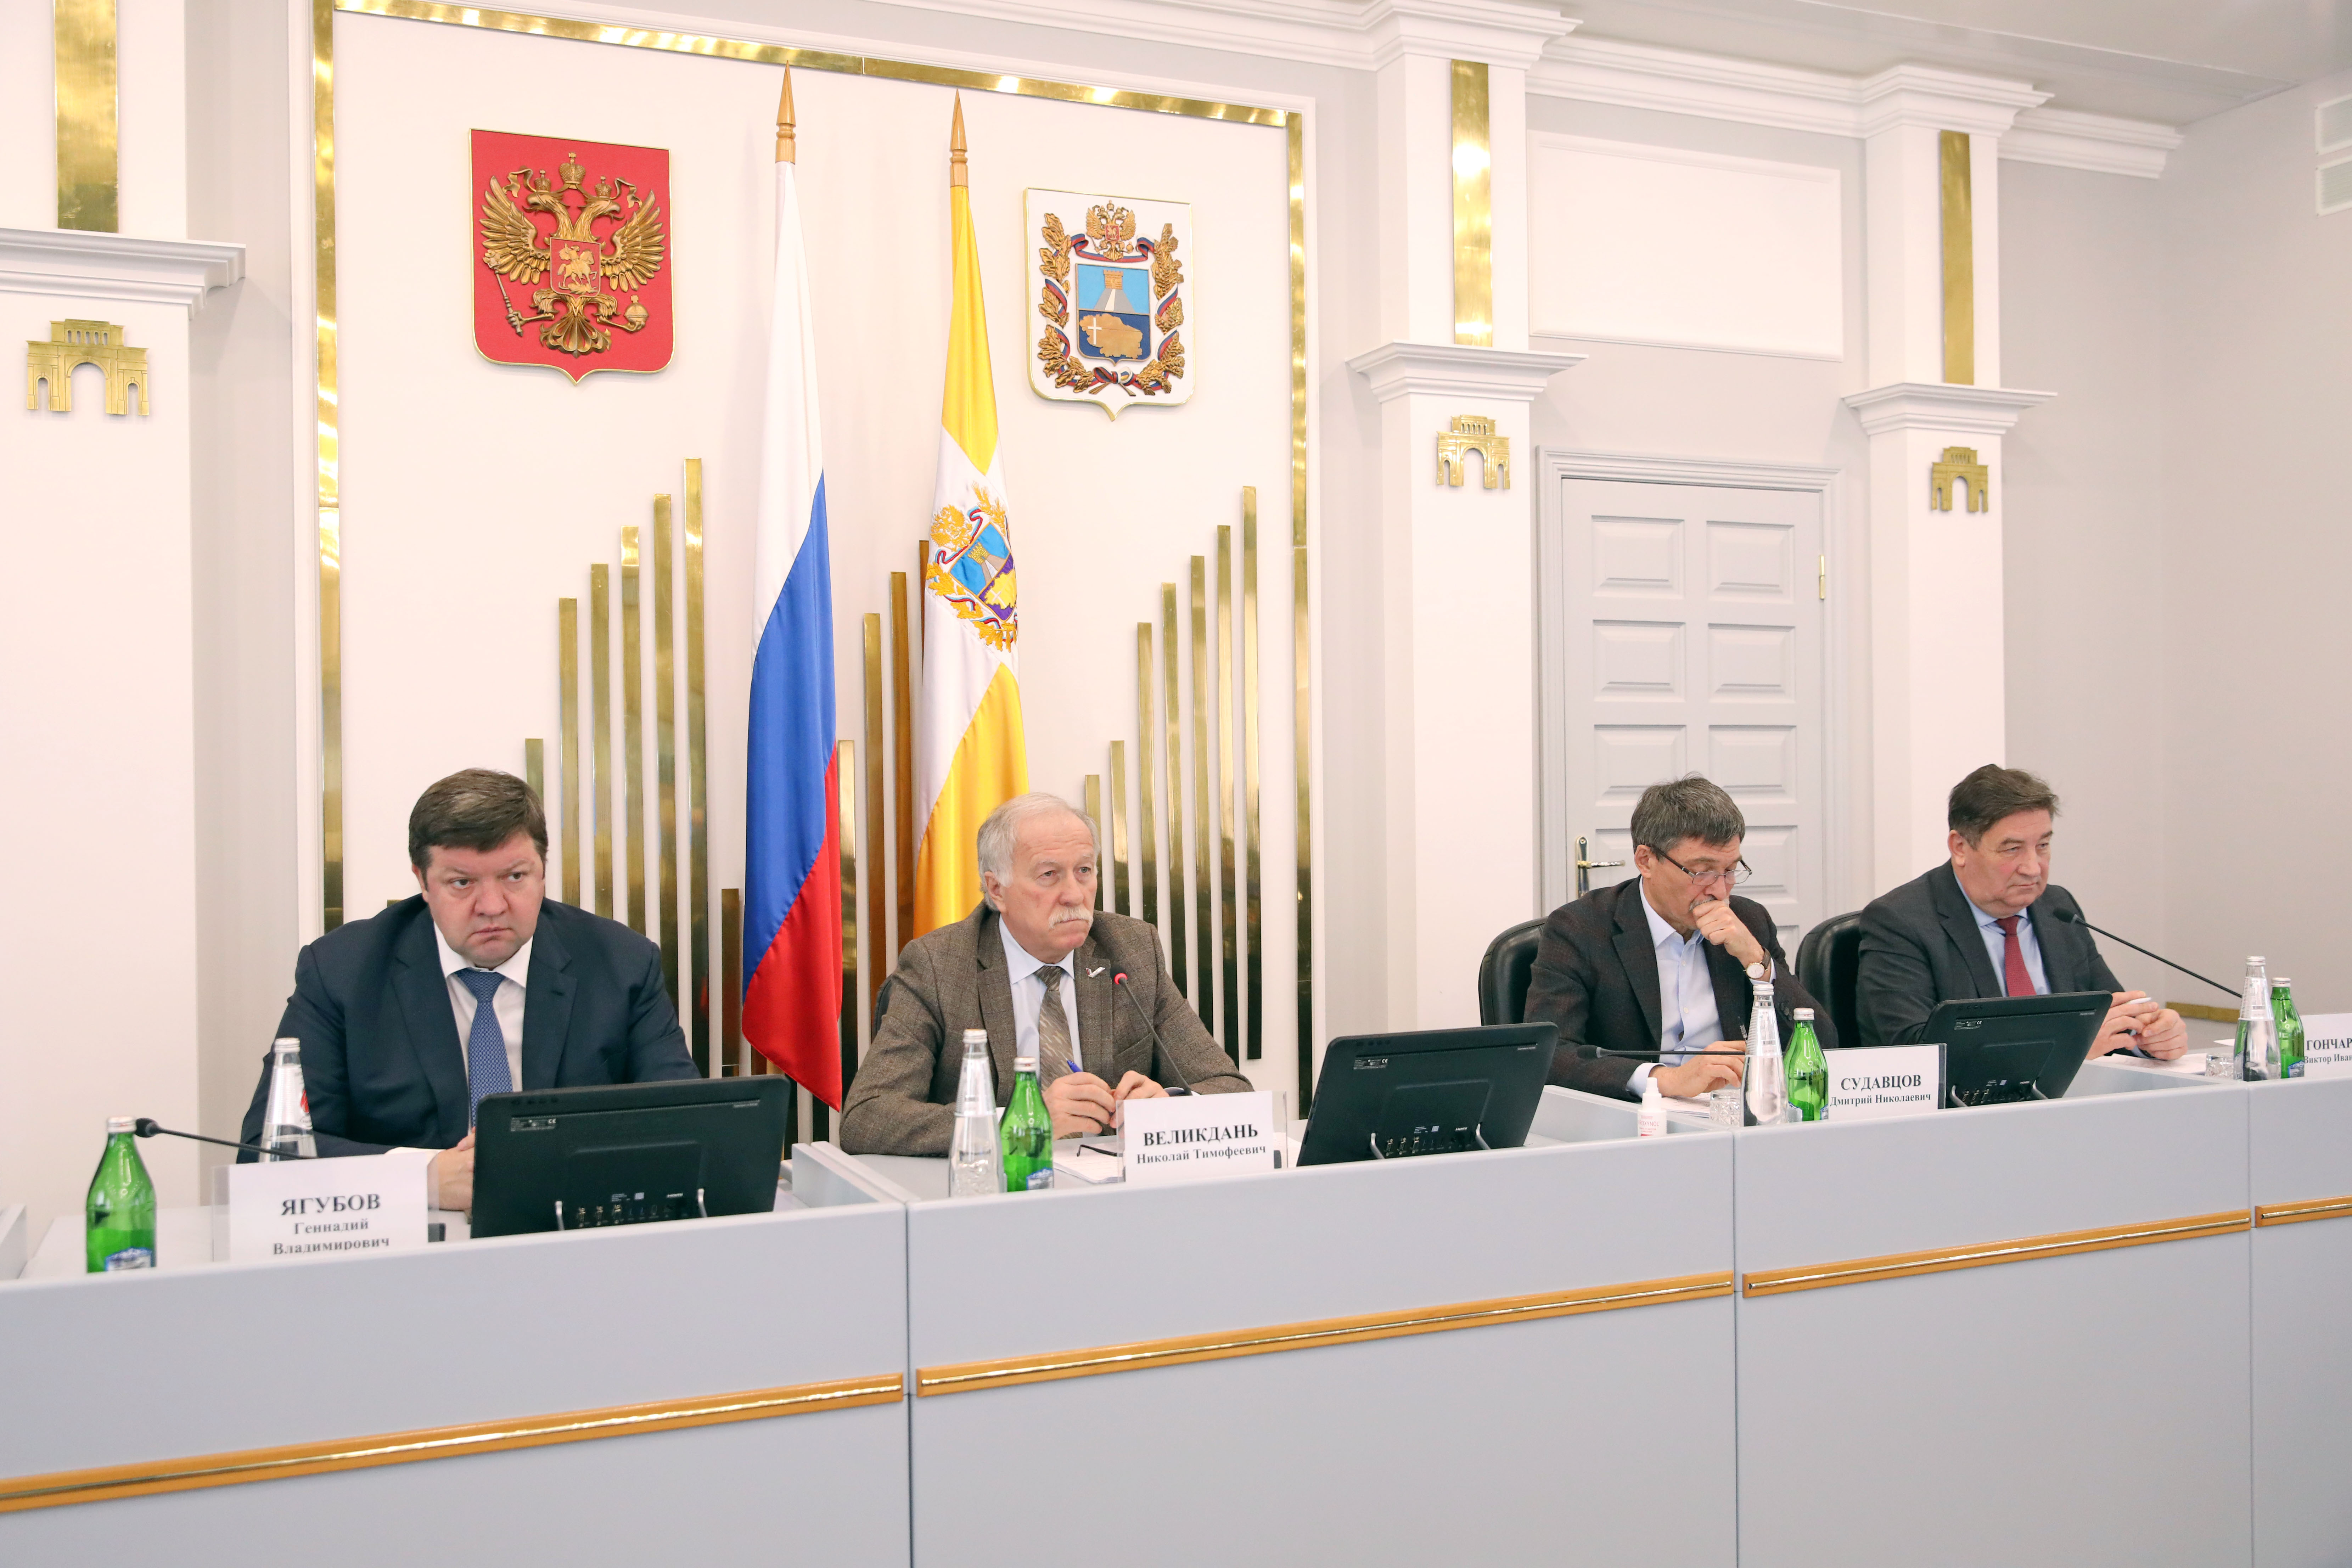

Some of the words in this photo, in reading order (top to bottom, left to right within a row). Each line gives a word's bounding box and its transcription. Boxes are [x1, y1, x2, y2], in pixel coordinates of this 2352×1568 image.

[2306, 1038, 2352, 1051] ГОНЧАР
[2304, 1056, 2331, 1064] Виктор
[1841, 1074, 1921, 1091] СУДАВЦОВ
[1830, 1095, 1872, 1107] Дмитрий
[1875, 1094, 1931, 1103] Николаевич
[1144, 1124, 1258, 1146] ВЕЛИКДАНЬ
[1137, 1151, 1189, 1164] Николай
[1193, 1146, 1266, 1159] Тимофеевич
[281, 1193, 381, 1216] ЯГУБОВ
[294, 1218, 369, 1235] Геннадий
[273, 1238, 389, 1255] Владимирович
